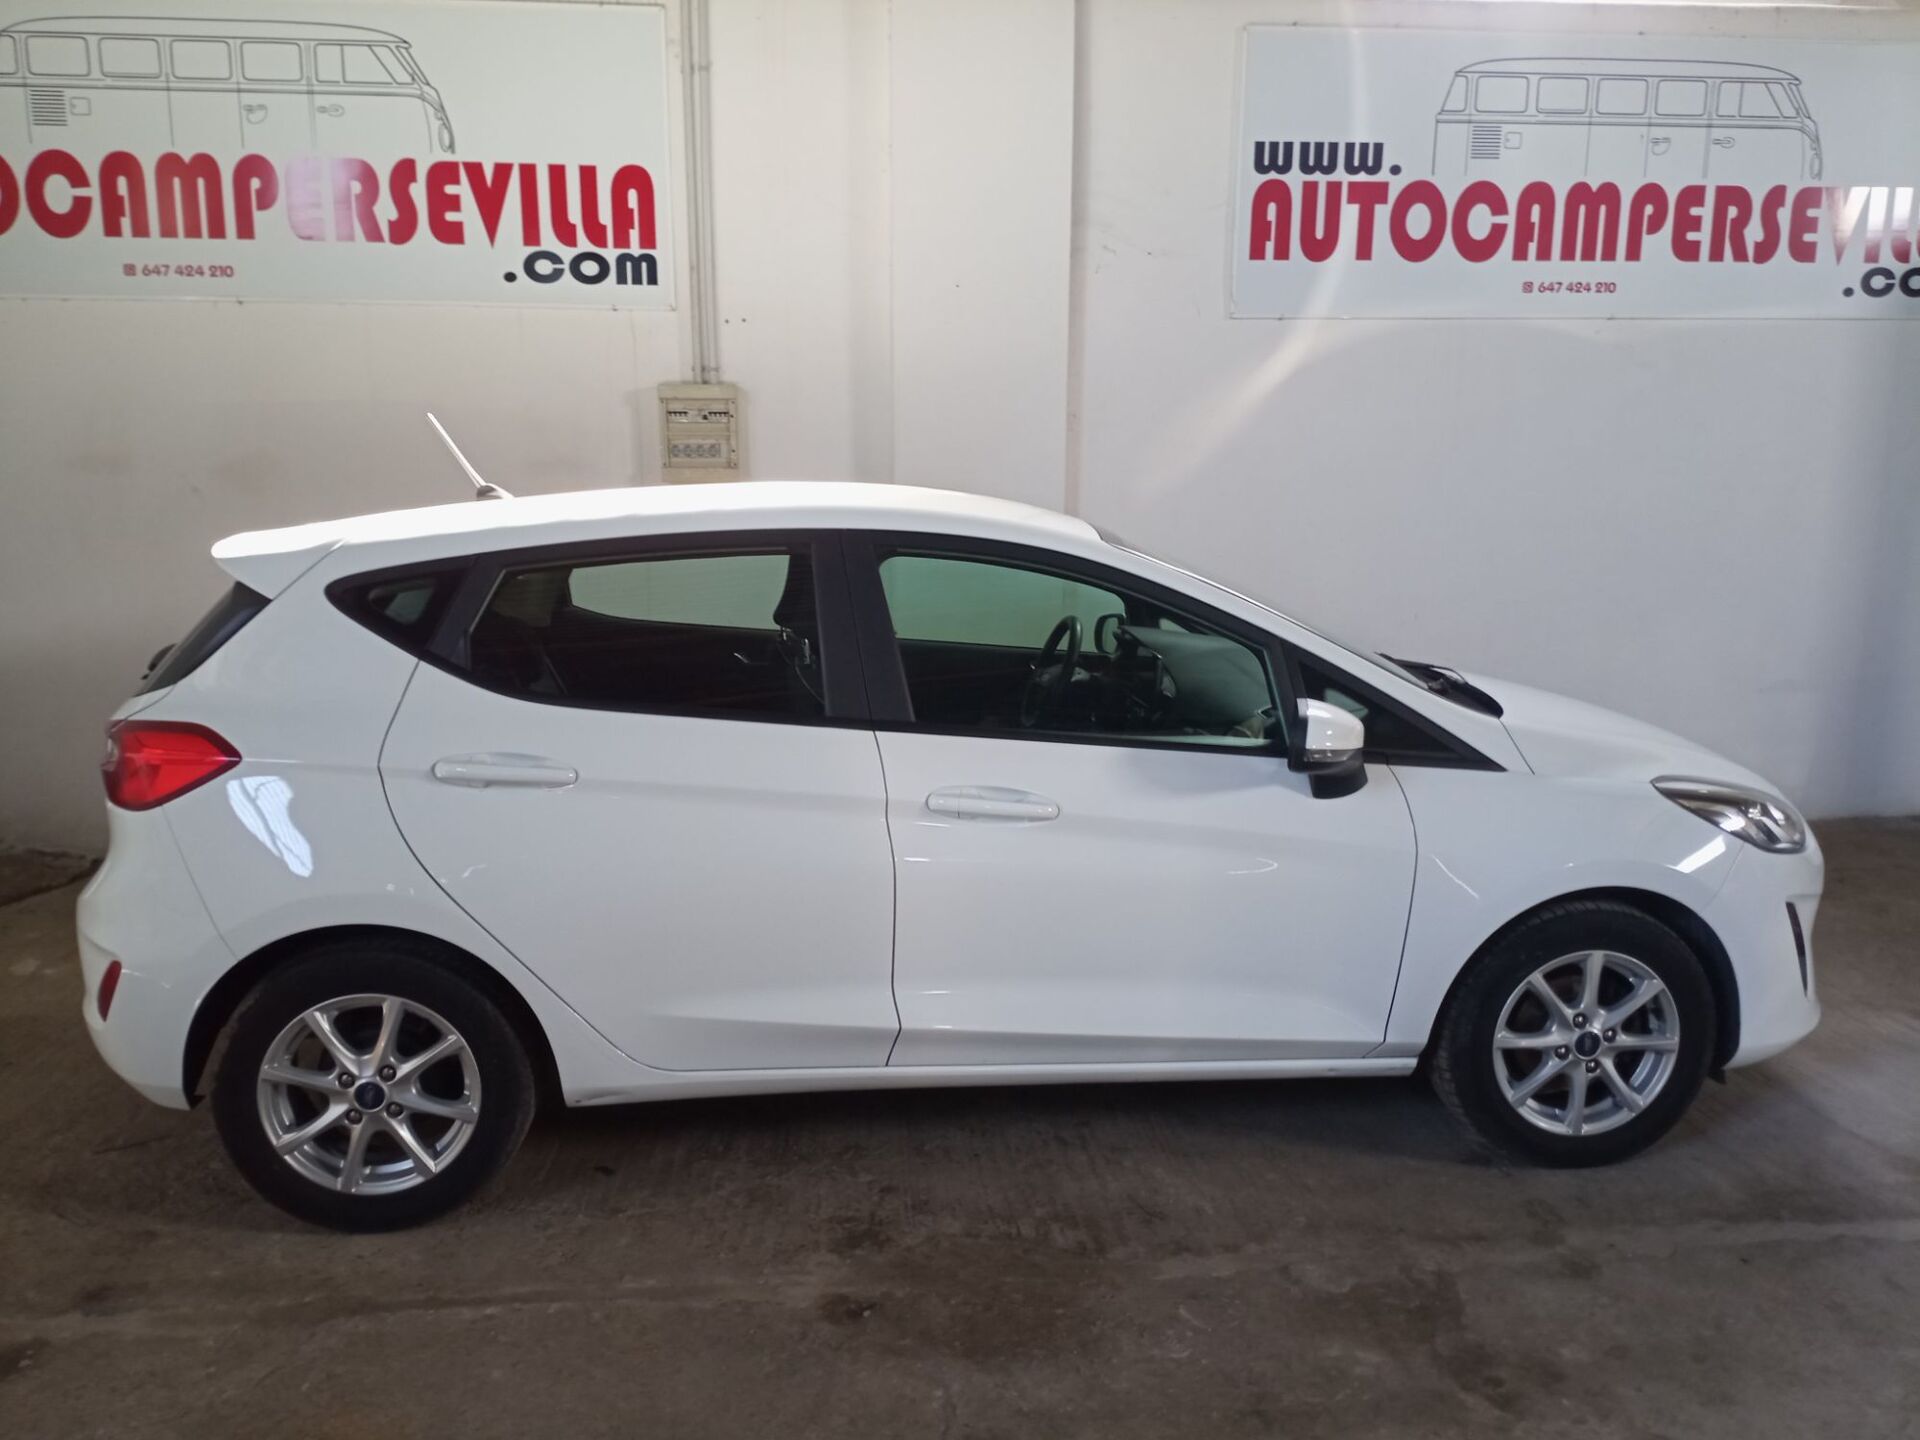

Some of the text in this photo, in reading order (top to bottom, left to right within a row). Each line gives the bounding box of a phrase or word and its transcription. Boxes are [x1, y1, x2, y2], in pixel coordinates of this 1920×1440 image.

[1254, 141, 1402, 176] www.
[1248, 178, 1920, 266] AUTOCAMPERSEVIL
[142, 264, 234, 278] 647 424 210
[1538, 282, 1617, 293] 647 424 210
